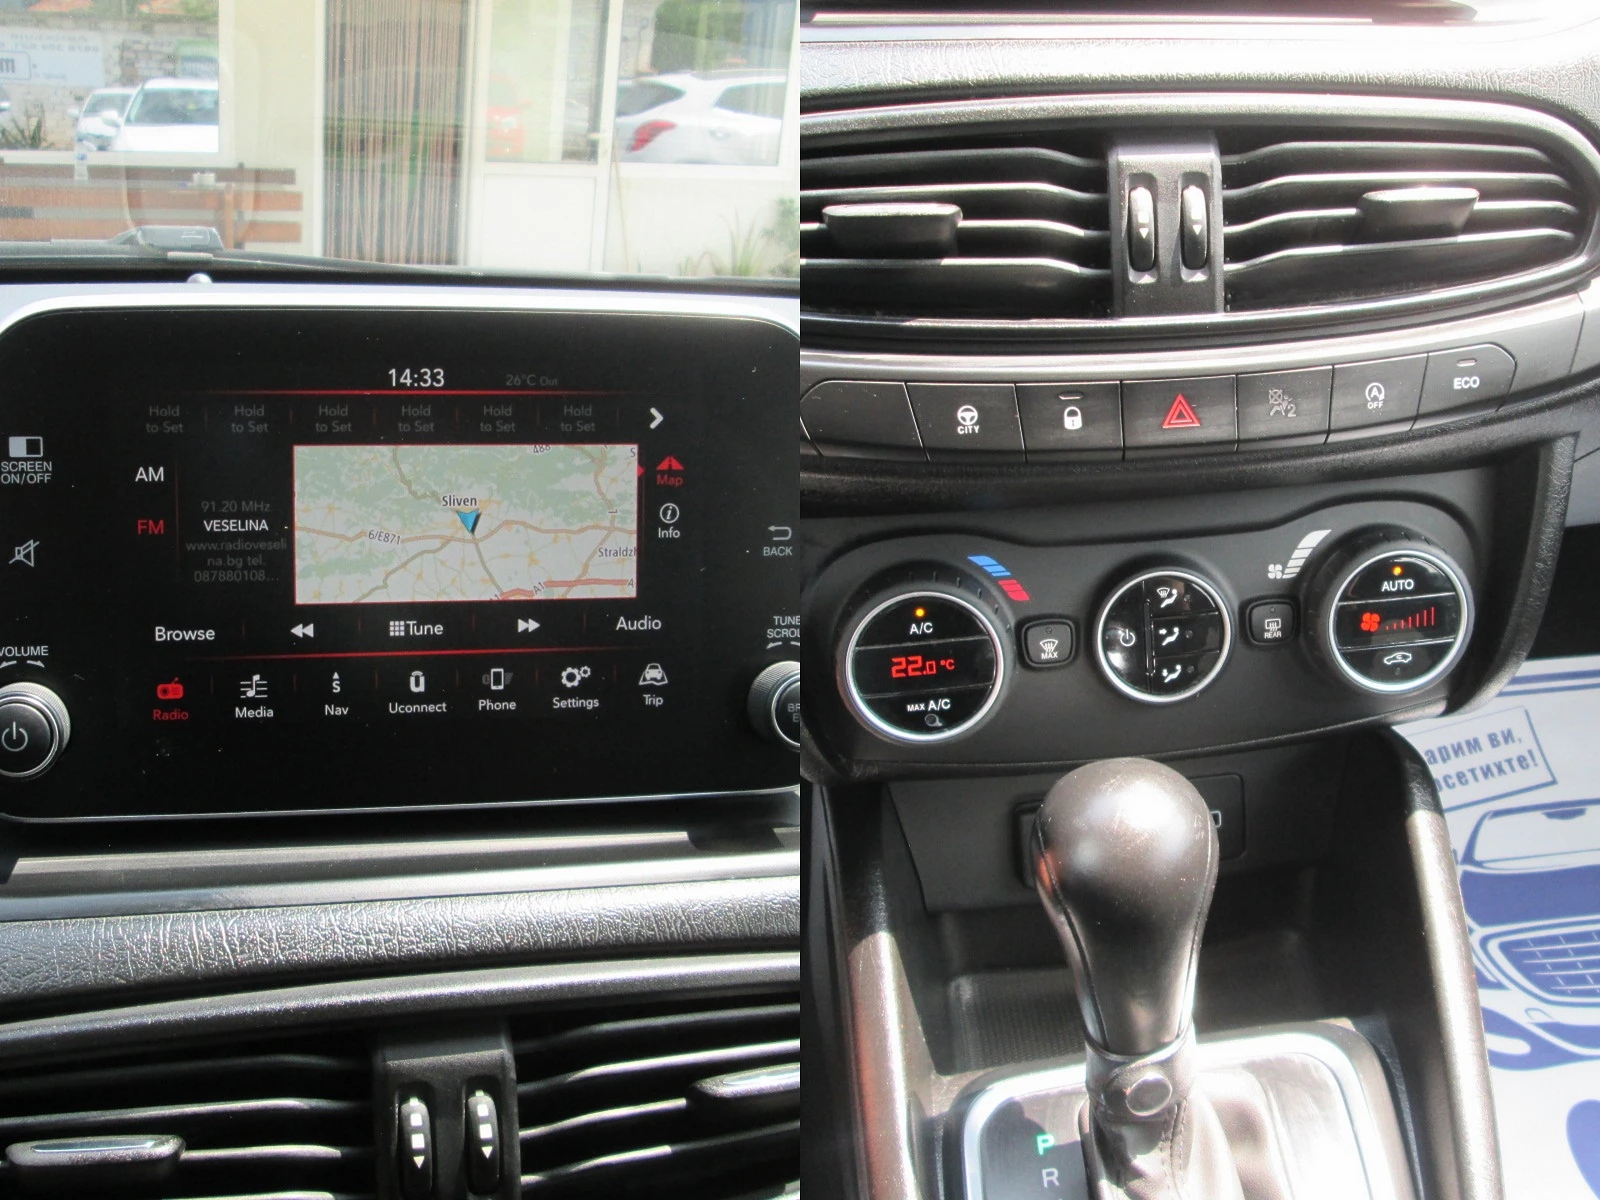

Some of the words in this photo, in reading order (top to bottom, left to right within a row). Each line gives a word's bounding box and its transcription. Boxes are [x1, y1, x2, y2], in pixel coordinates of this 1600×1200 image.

[388, 368, 445, 387] 14:33
[505, 374, 537, 387] 26°C
[1453, 376, 1480, 390] ECO
[148, 405, 180, 418] Hold
[234, 405, 265, 418] Hold
[318, 404, 349, 417] Hold
[401, 404, 432, 417] Hold
[483, 404, 513, 417] Hold
[563, 404, 593, 417] Hold
[1367, 401, 1384, 410] OFF
[145, 422, 158, 434] to
[162, 422, 184, 435] Set
[230, 422, 243, 434] to
[247, 422, 269, 435] Set
[315, 421, 329, 433] to
[331, 421, 353, 434] Set
[399, 421, 412, 433] to
[414, 421, 435, 434] Set
[480, 421, 493, 433] to
[496, 421, 516, 434] Set
[560, 420, 574, 432] to
[576, 420, 596, 433] Set
[957, 425, 980, 435] CITY
[0, 461, 52, 472] SCREEN
[0, 473, 52, 485] ON/OFF
[135, 466, 164, 482] AM
[656, 474, 683, 487] Map
[201, 501, 238, 513] 91.20
[241, 501, 271, 513] MHz
[441, 494, 478, 507] Sliven
[136, 520, 165, 535] FM
[203, 519, 269, 532] VESELINA
[367, 530, 401, 546] 6/E871
[657, 526, 681, 539] Info
[185, 538, 288, 552] www.radioveseli
[597, 545, 636, 558] Straldz
[762, 546, 793, 557] BACK
[206, 554, 244, 569] na.bg
[246, 553, 267, 567] tel.
[1381, 578, 1414, 592] AUTO
[405, 620, 445, 637] Tune
[615, 615, 662, 631] Audio
[909, 622, 934, 636] A/C
[154, 625, 216, 642] Browse
[1263, 629, 1283, 639] REAR
[1041, 651, 1059, 660] MAX
[890, 655, 937, 679] 22.0
[939, 658, 956, 671] °C
[389, 700, 448, 715] Uconnect
[478, 698, 518, 712] Phone
[552, 694, 600, 710] Settings
[642, 693, 665, 709] Trip
[907, 703, 925, 712] MAX
[928, 698, 951, 711] A/C
[152, 707, 190, 722] Radio
[234, 705, 275, 719] Media
[324, 703, 349, 717] Nav
[1487, 727, 1523, 750] ви,
[1036, 1133, 1055, 1156] P
[1041, 1168, 1060, 1188] R
